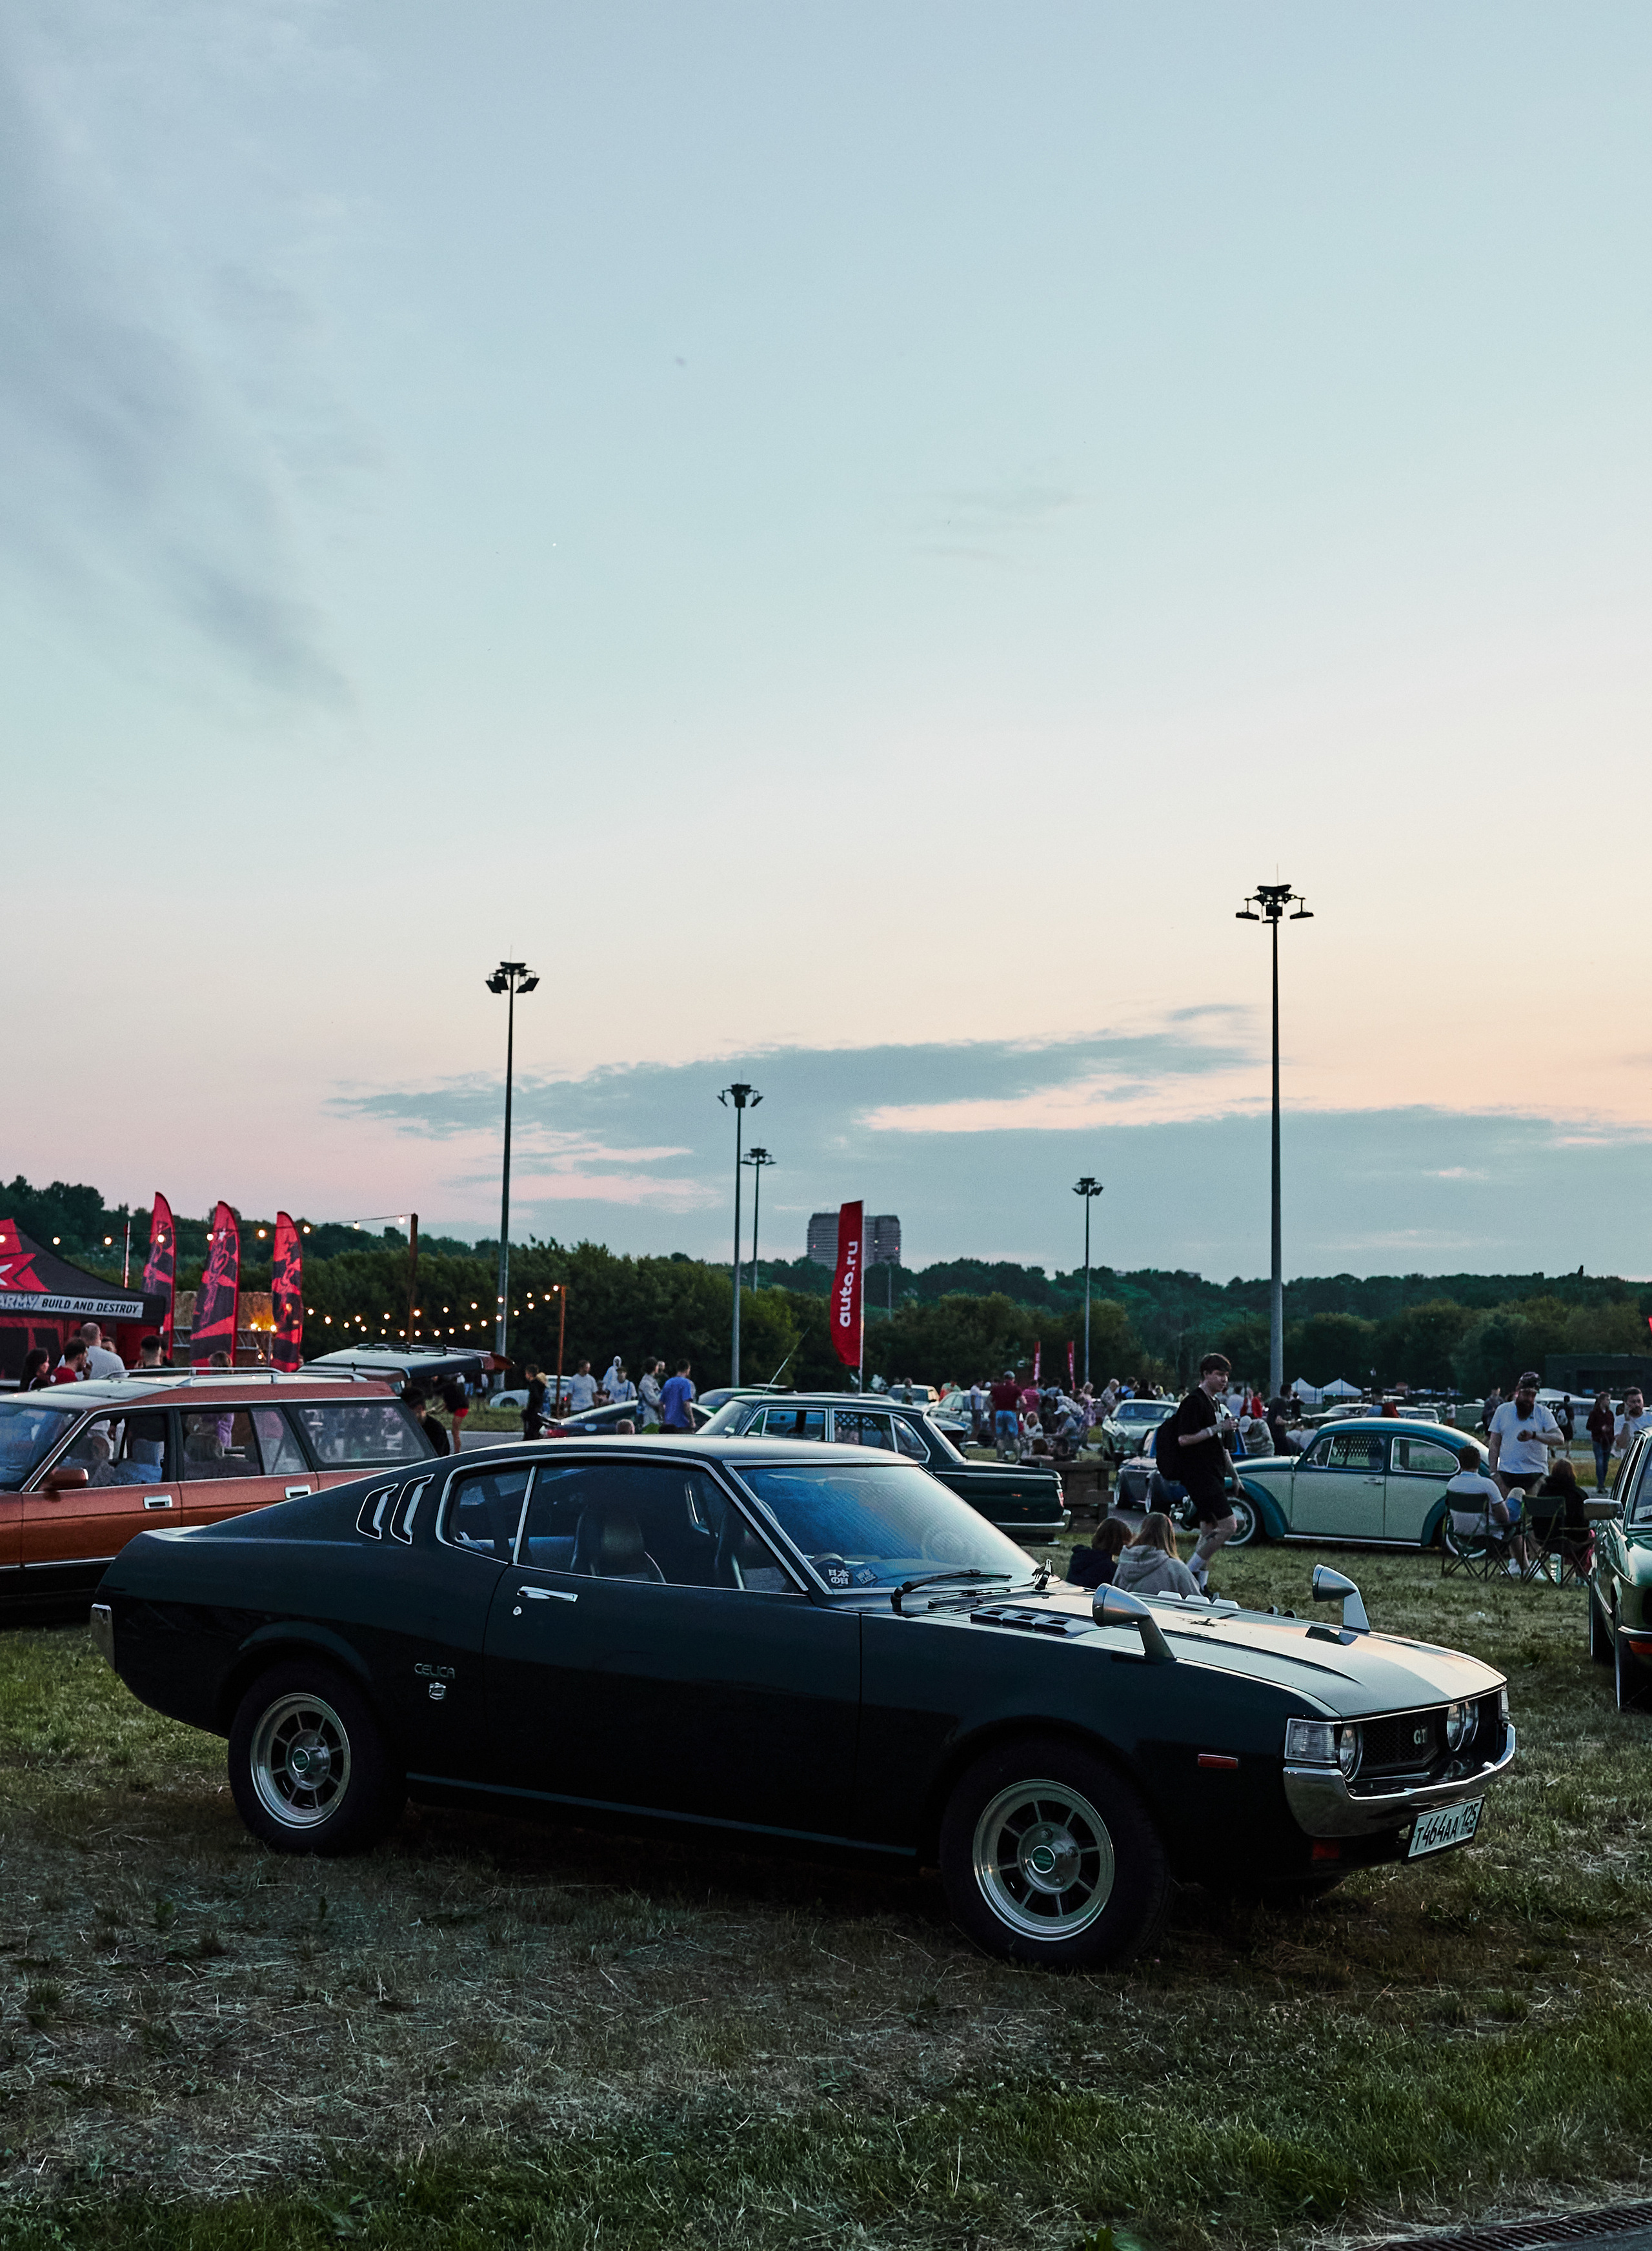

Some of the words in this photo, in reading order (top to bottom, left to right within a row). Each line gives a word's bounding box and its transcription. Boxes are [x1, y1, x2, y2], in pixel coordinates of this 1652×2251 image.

[839, 1241, 858, 1327] auto.ru
[42, 1298, 71, 1309] BUILD
[74, 1301, 94, 1311] AND
[96, 1303, 139, 1314] DESTROY
[829, 1569, 849, 1578] 日本
[414, 1663, 456, 1679] CELICA
[1413, 1726, 1428, 1745] GT
[1415, 1814, 1459, 1850] T464AA
[1462, 1802, 1480, 1827] 125
